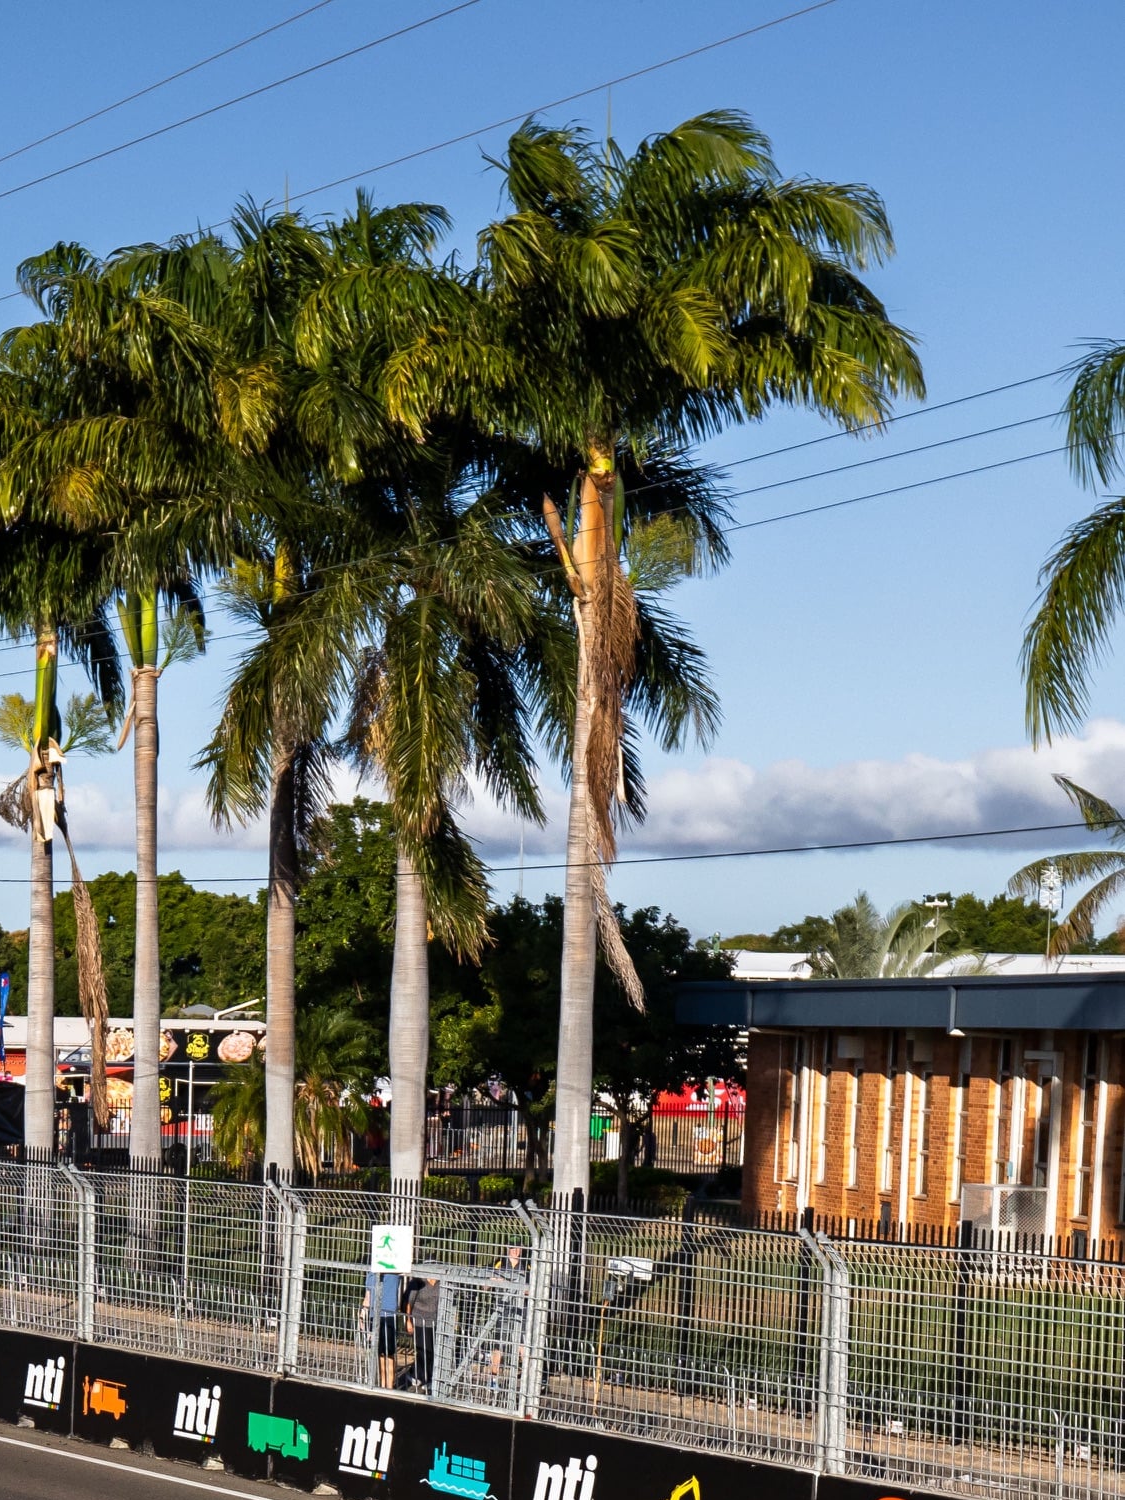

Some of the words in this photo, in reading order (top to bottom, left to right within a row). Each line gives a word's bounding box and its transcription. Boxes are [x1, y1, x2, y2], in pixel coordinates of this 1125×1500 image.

[24, 1356, 66, 1404] nti
[174, 1385, 222, 1436] nti
[339, 1417, 394, 1473] nti
